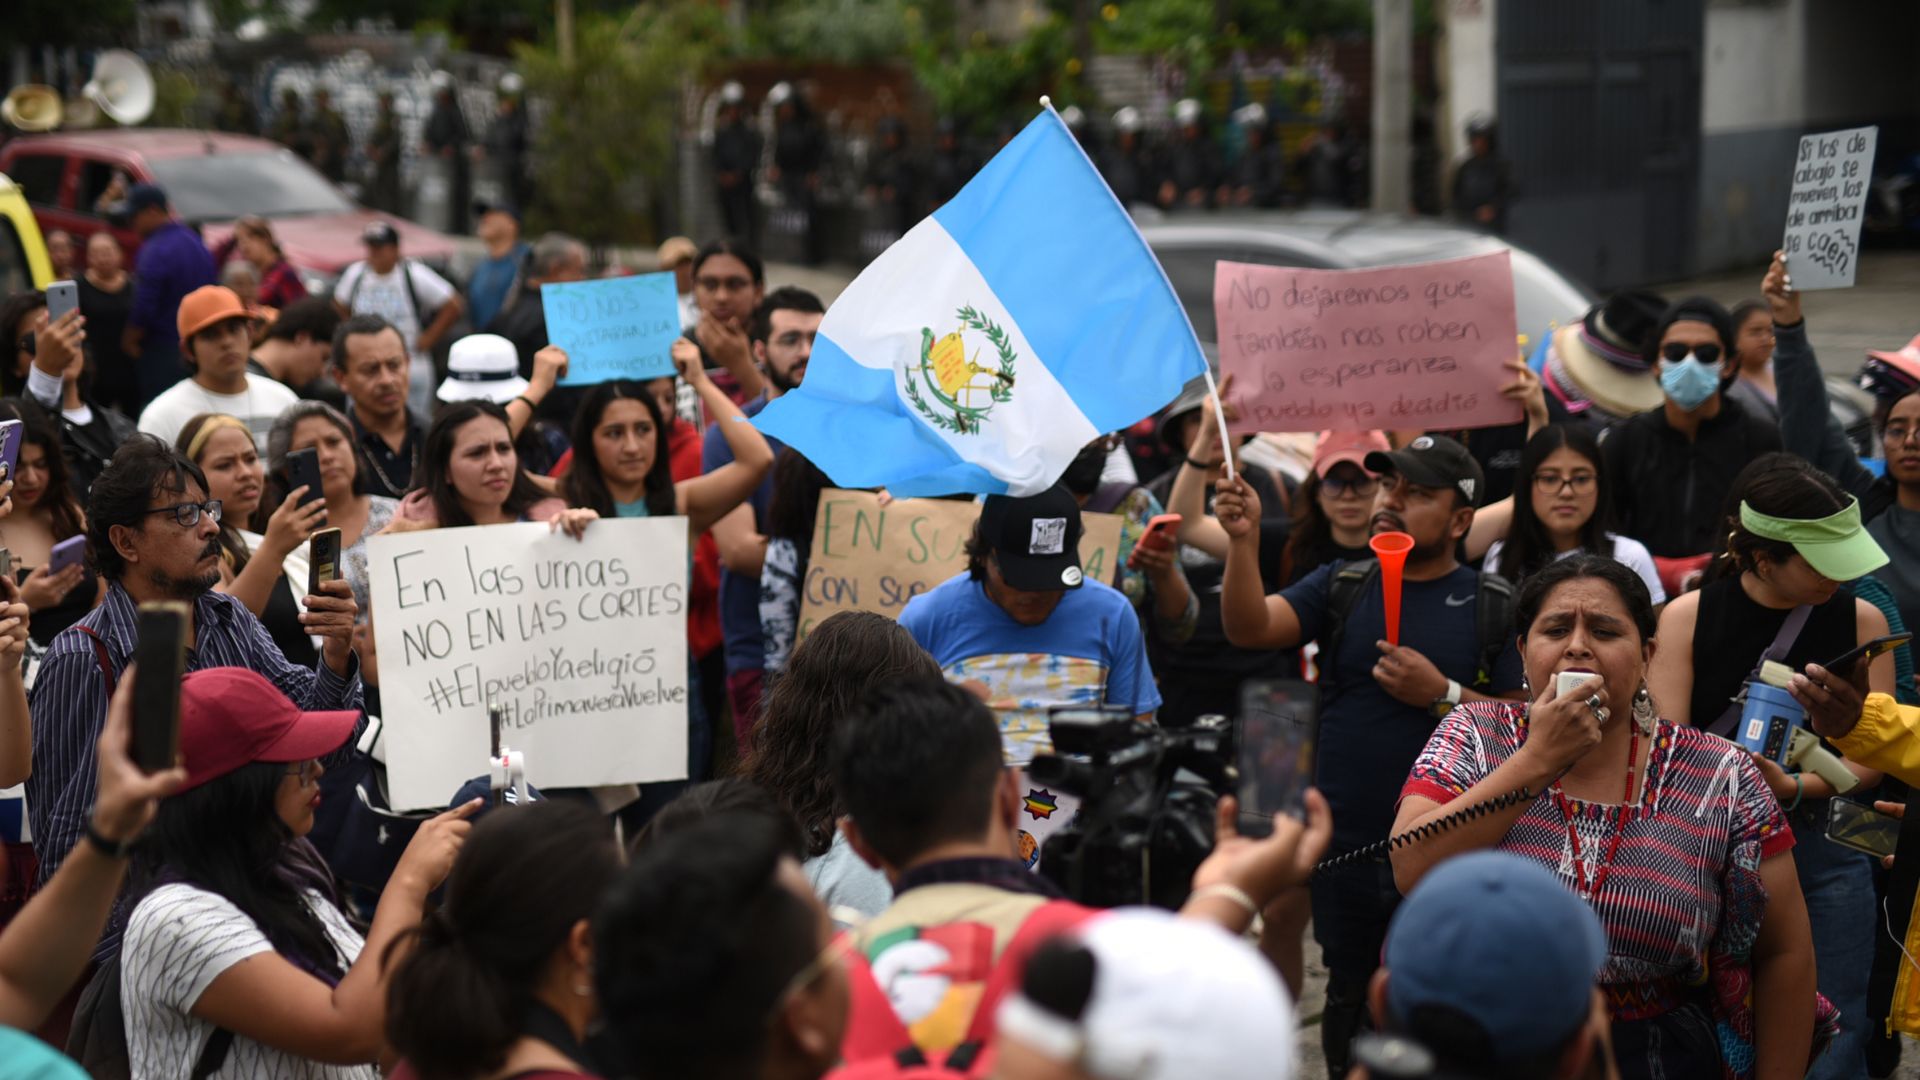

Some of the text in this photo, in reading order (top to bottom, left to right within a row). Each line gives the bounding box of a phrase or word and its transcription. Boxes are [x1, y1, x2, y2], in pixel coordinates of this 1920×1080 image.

[1817, 137, 1839, 160] los
[1846, 131, 1866, 154] de
[1794, 160, 1859, 186] abajo se
[1842, 180, 1863, 199] los
[1787, 203, 1858, 228] de arriba
[1786, 234, 1801, 253] se
[1227, 274, 1474, 319] No dejaremos que
[1396, 317, 1481, 342] roben
[1342, 399, 1376, 424] ya
[819, 501, 886, 559] EN
[392, 544, 630, 610] En las urnas
[804, 566, 859, 607] CON
[402, 582, 683, 666] NO EN LAS CORTES
